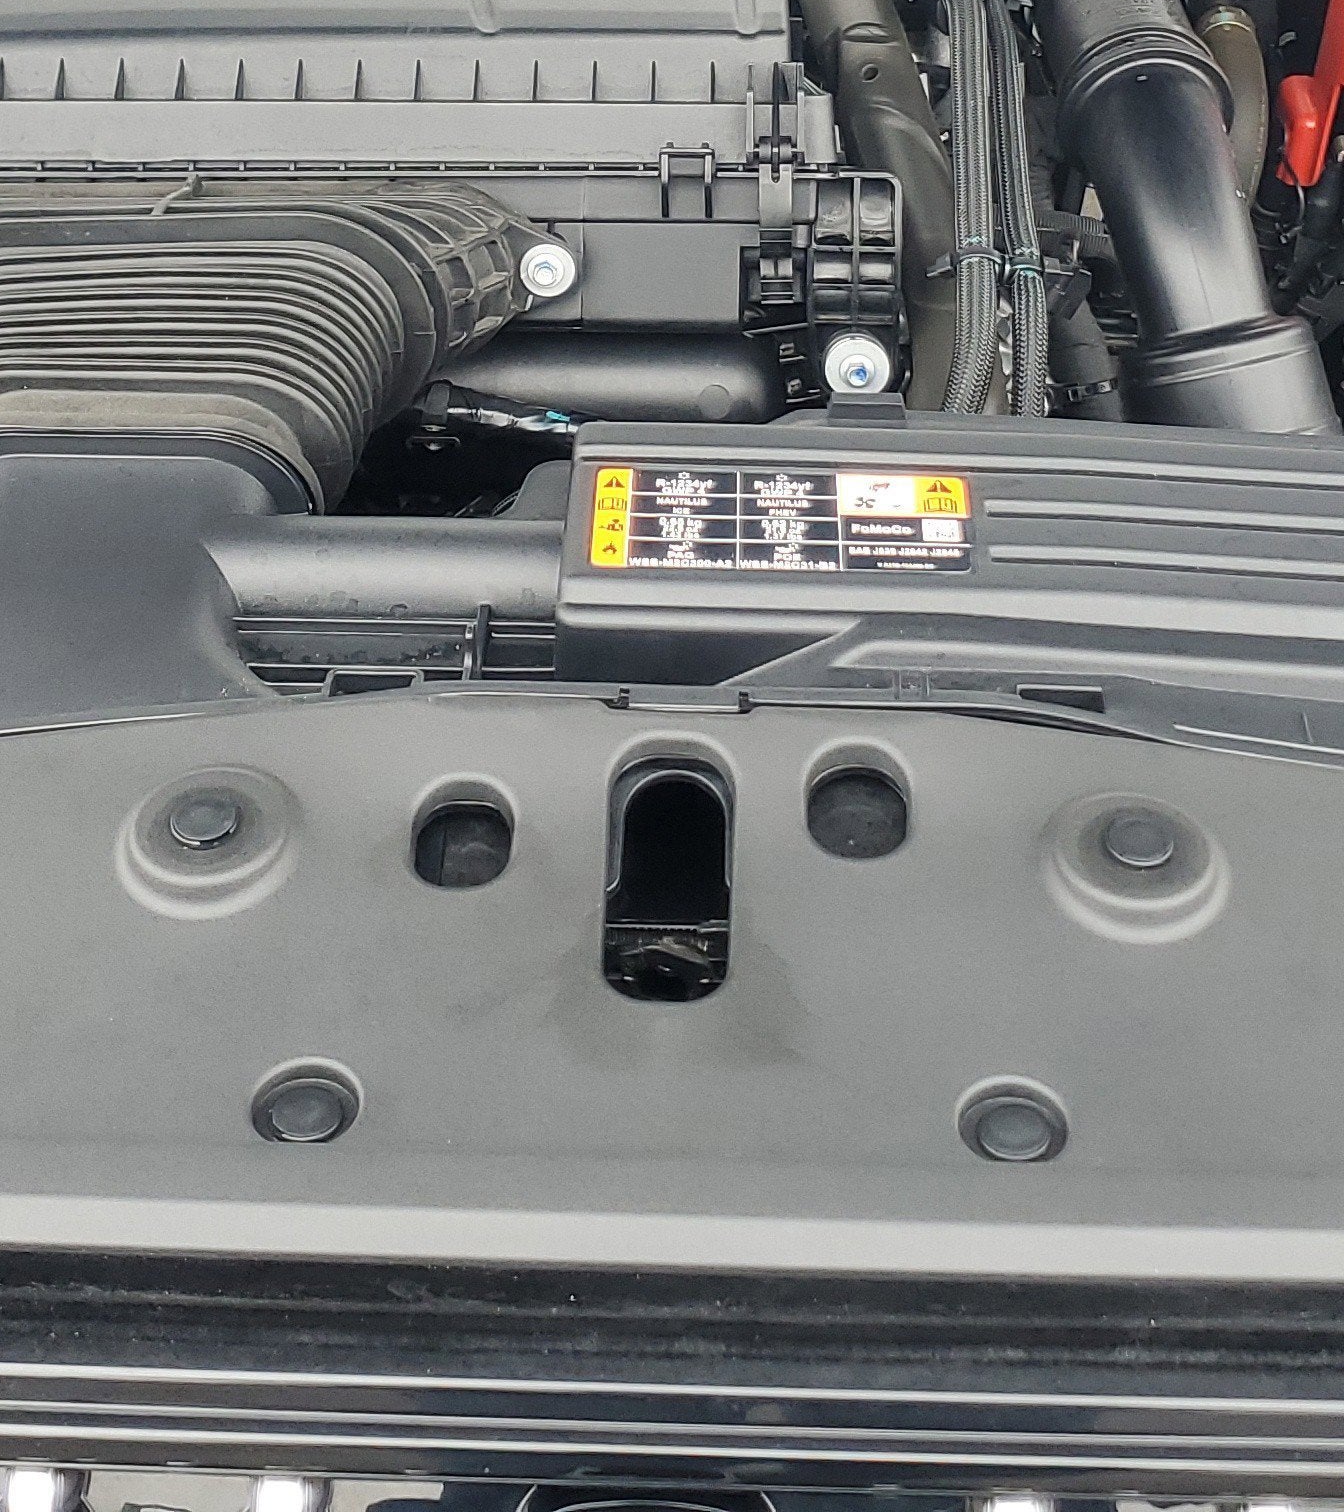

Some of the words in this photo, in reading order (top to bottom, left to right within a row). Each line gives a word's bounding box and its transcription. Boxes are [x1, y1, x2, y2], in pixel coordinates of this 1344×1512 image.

[655, 478, 713, 488] R-1234yf
[753, 480, 811, 490] R-1234yf
[656, 496, 708, 506] NAUTILUS
[756, 498, 809, 508] NAUTILUS
[768, 508, 797, 516] PHEV
[850, 522, 912, 534] FoMoCo
[666, 551, 695, 559] PAG
